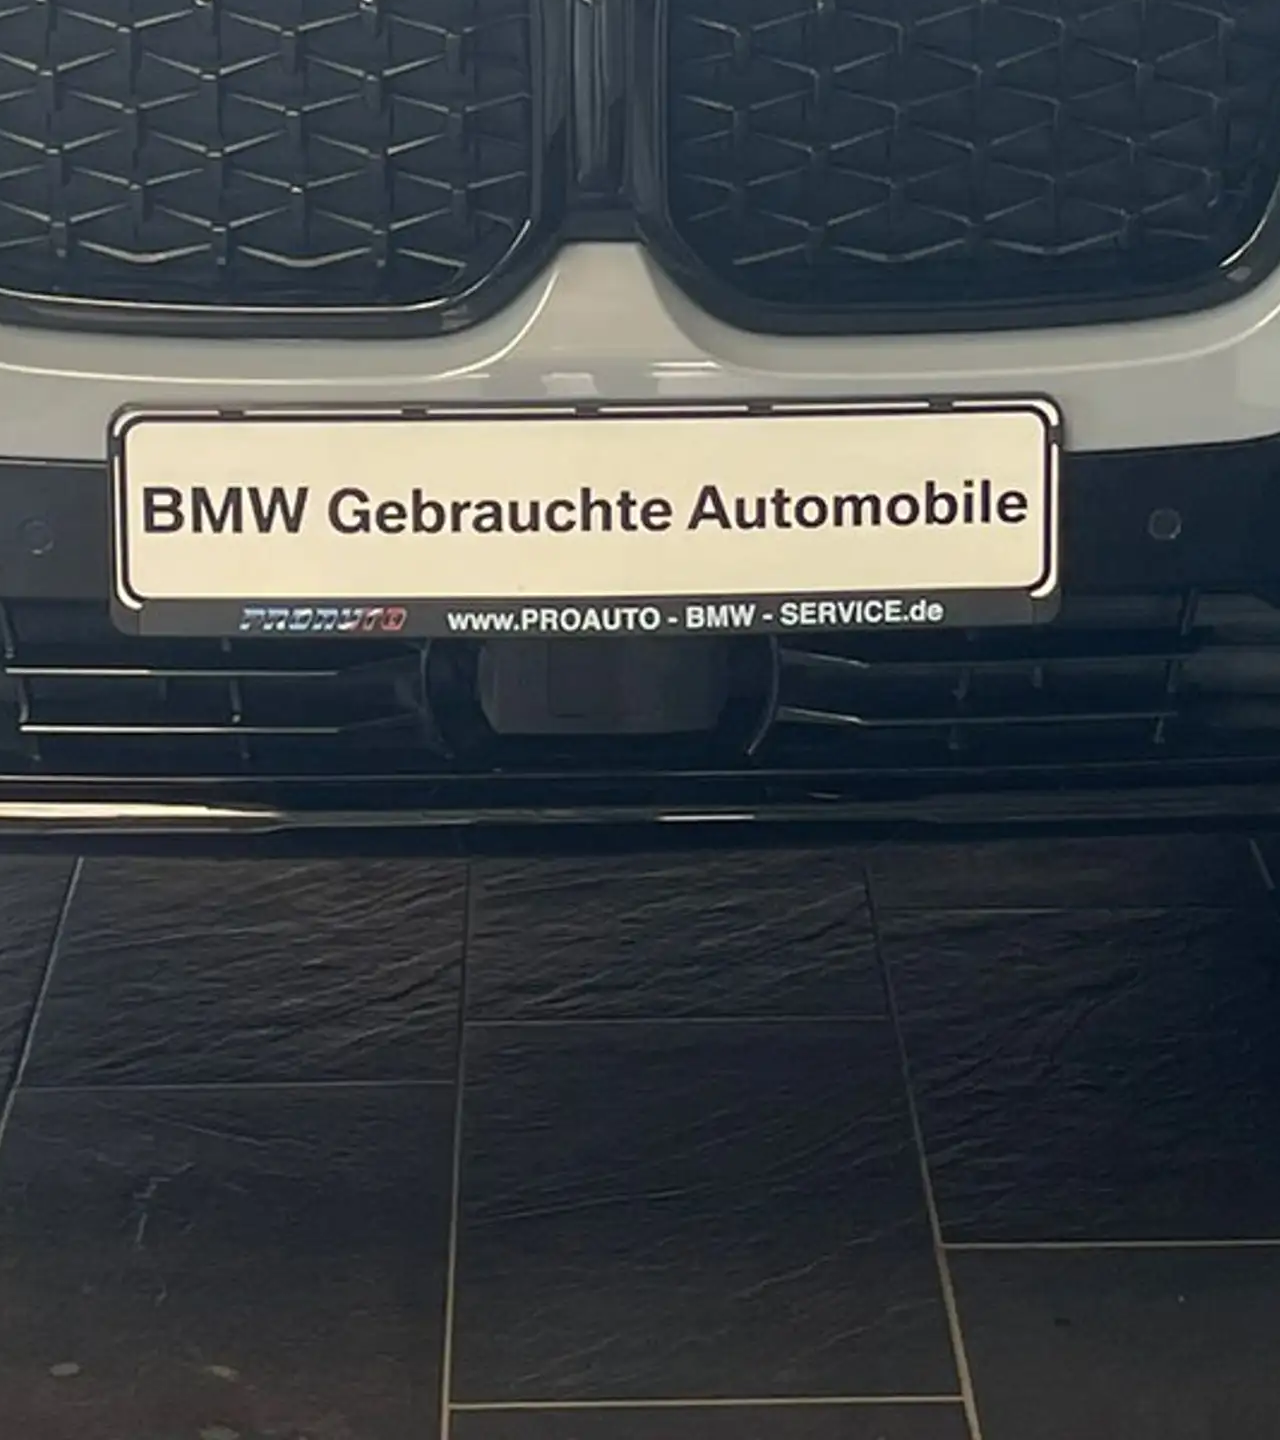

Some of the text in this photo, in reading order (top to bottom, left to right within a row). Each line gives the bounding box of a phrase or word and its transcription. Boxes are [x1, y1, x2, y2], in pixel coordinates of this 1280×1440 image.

[142, 479, 1028, 534] BMW Gebrauchte Automobile
[447, 606, 661, 631] www.PROAUTO
[685, 603, 756, 629] BMW
[779, 599, 944, 626] SERVICE.de
